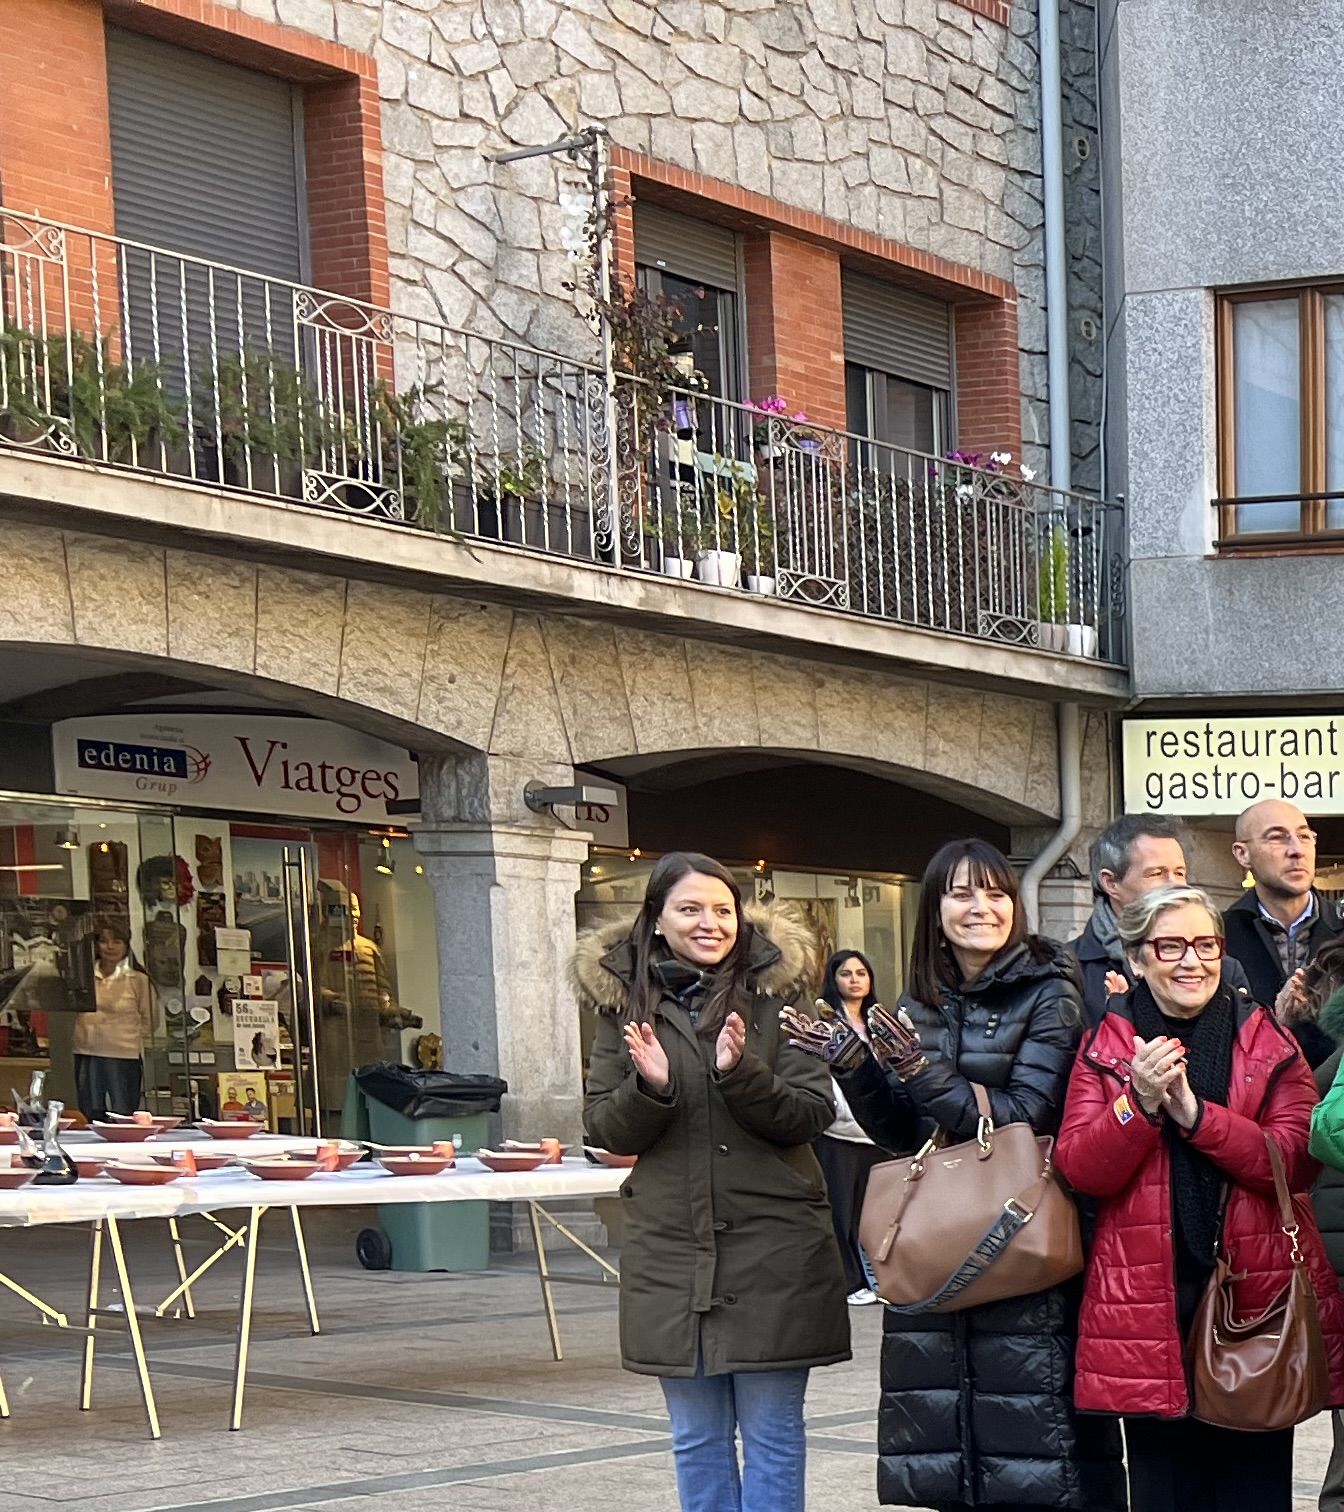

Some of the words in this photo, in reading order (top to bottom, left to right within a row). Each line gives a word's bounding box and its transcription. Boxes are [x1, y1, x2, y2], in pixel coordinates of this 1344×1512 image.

[1145, 720, 1338, 758] restaurant
[84, 744, 177, 774] edenia
[234, 736, 400, 814] Viatges
[135, 776, 178, 797] Grup
[1145, 762, 1341, 809] gastro-bar
